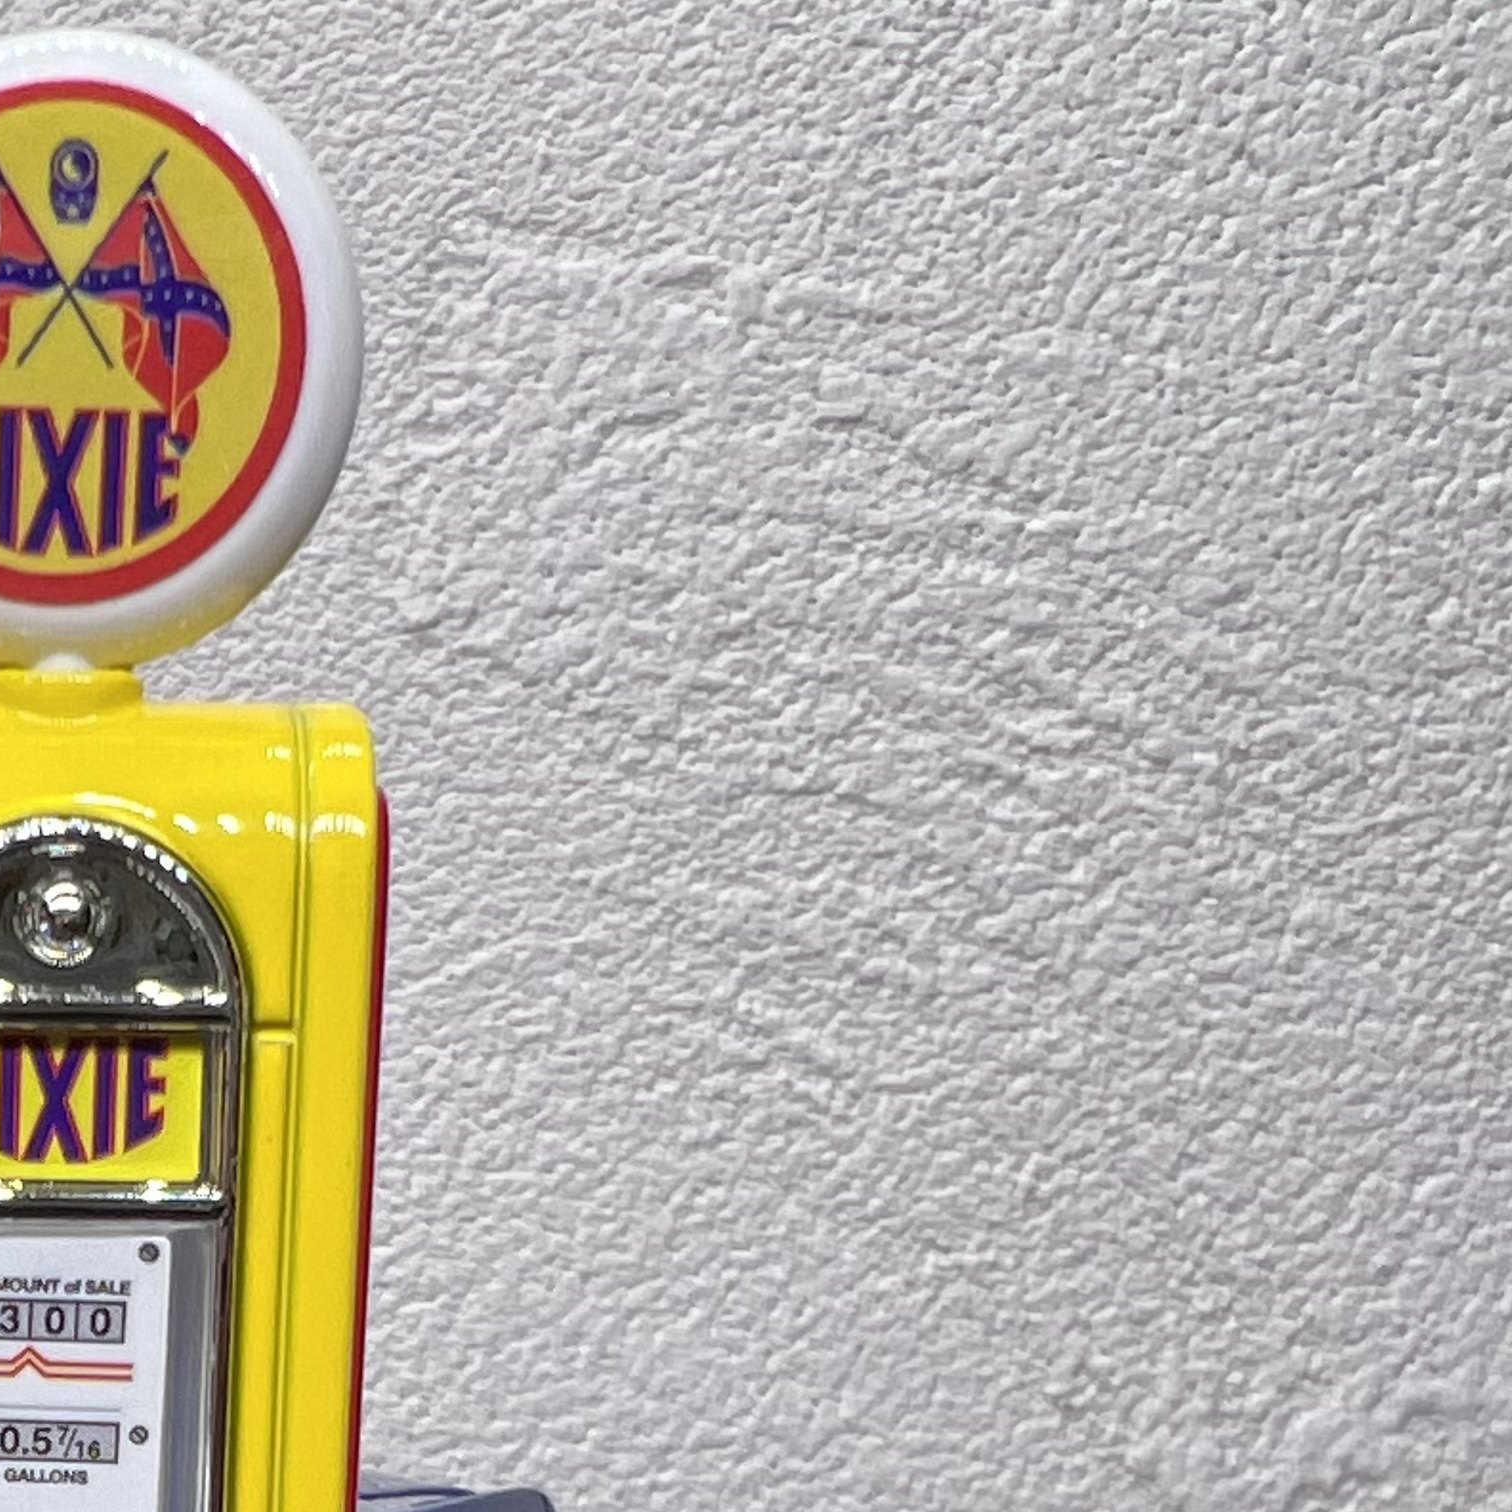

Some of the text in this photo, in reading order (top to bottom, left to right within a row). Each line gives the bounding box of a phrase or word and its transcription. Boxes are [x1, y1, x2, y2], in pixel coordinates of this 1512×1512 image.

[64, 1278, 82, 1293] of
[85, 1279, 131, 1297] SALE
[4, 1467, 88, 1485] GALLONS
